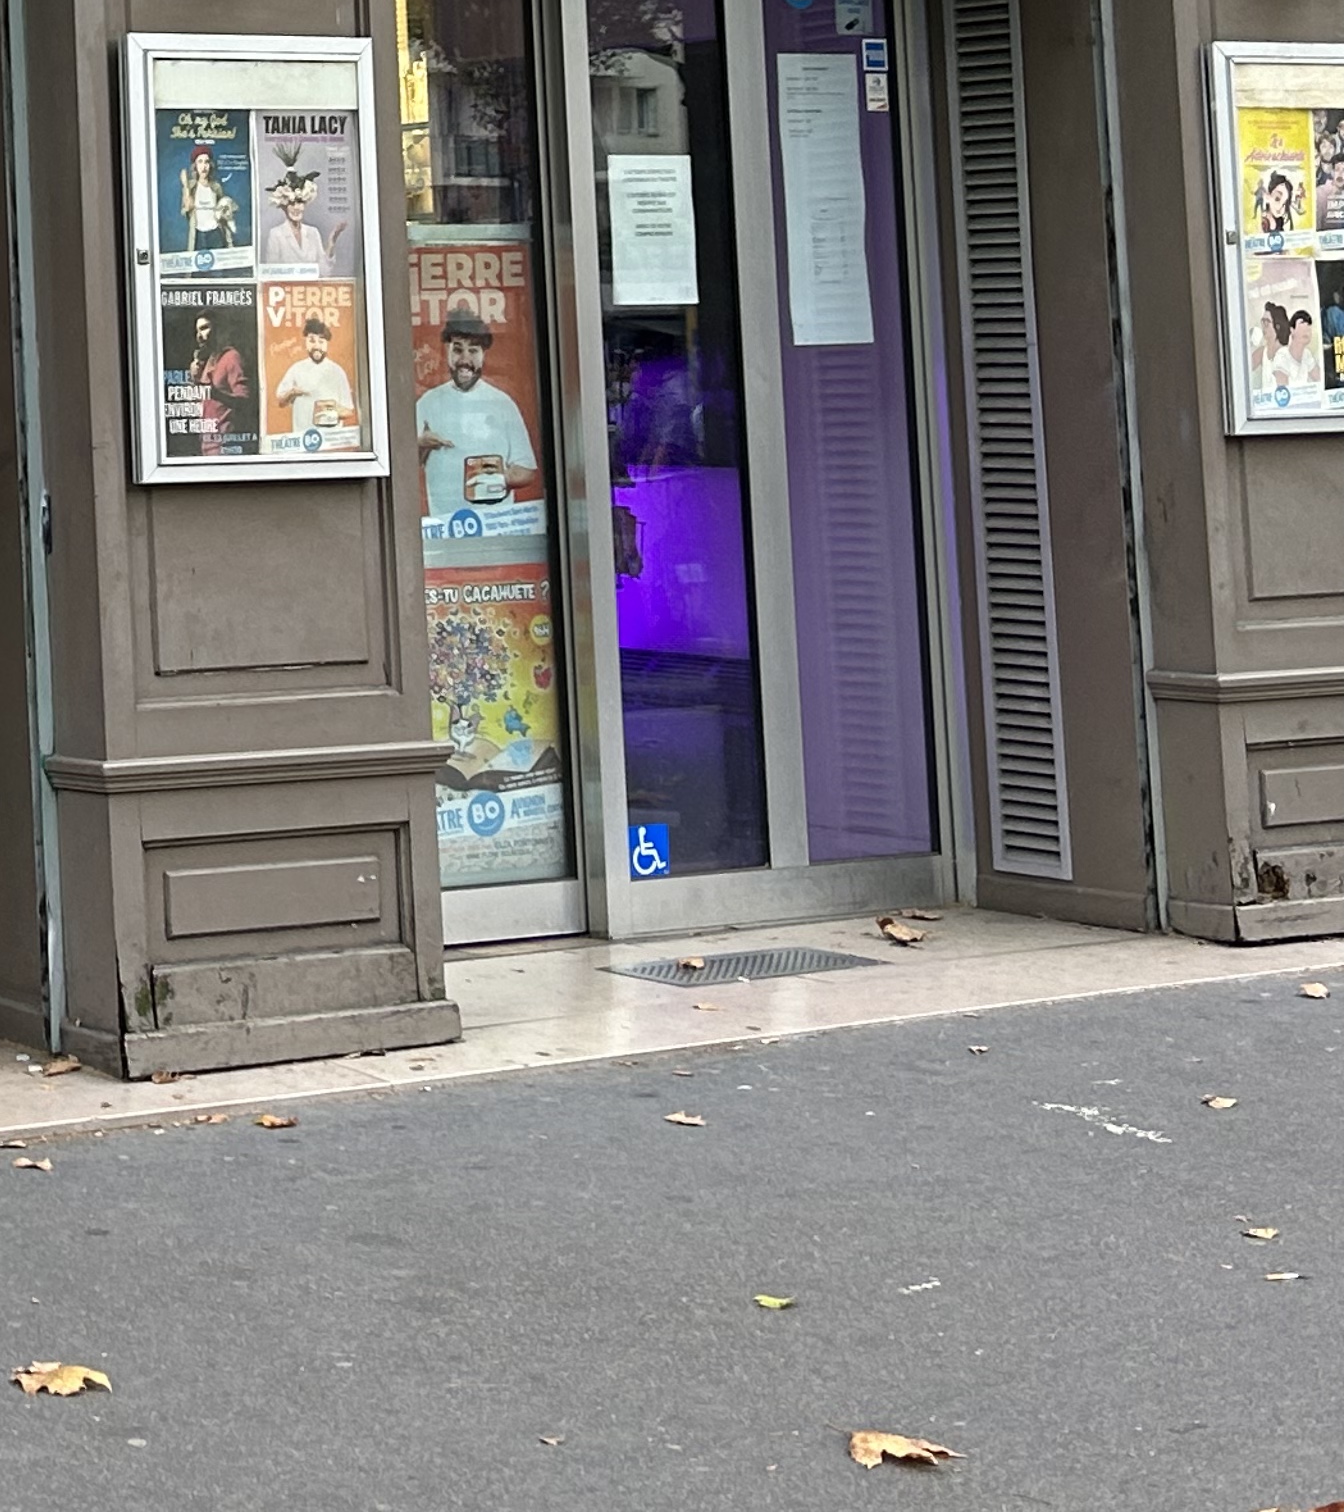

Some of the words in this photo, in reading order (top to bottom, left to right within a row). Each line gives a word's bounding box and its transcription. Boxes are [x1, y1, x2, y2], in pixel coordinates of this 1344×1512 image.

[263, 115, 307, 134] TANIA
[310, 115, 348, 134] LACY
[161, 291, 204, 306] GABRIEL
[168, 385, 211, 401] PENDANT
[452, 516, 479, 538] BO
[471, 799, 500, 824] BO
